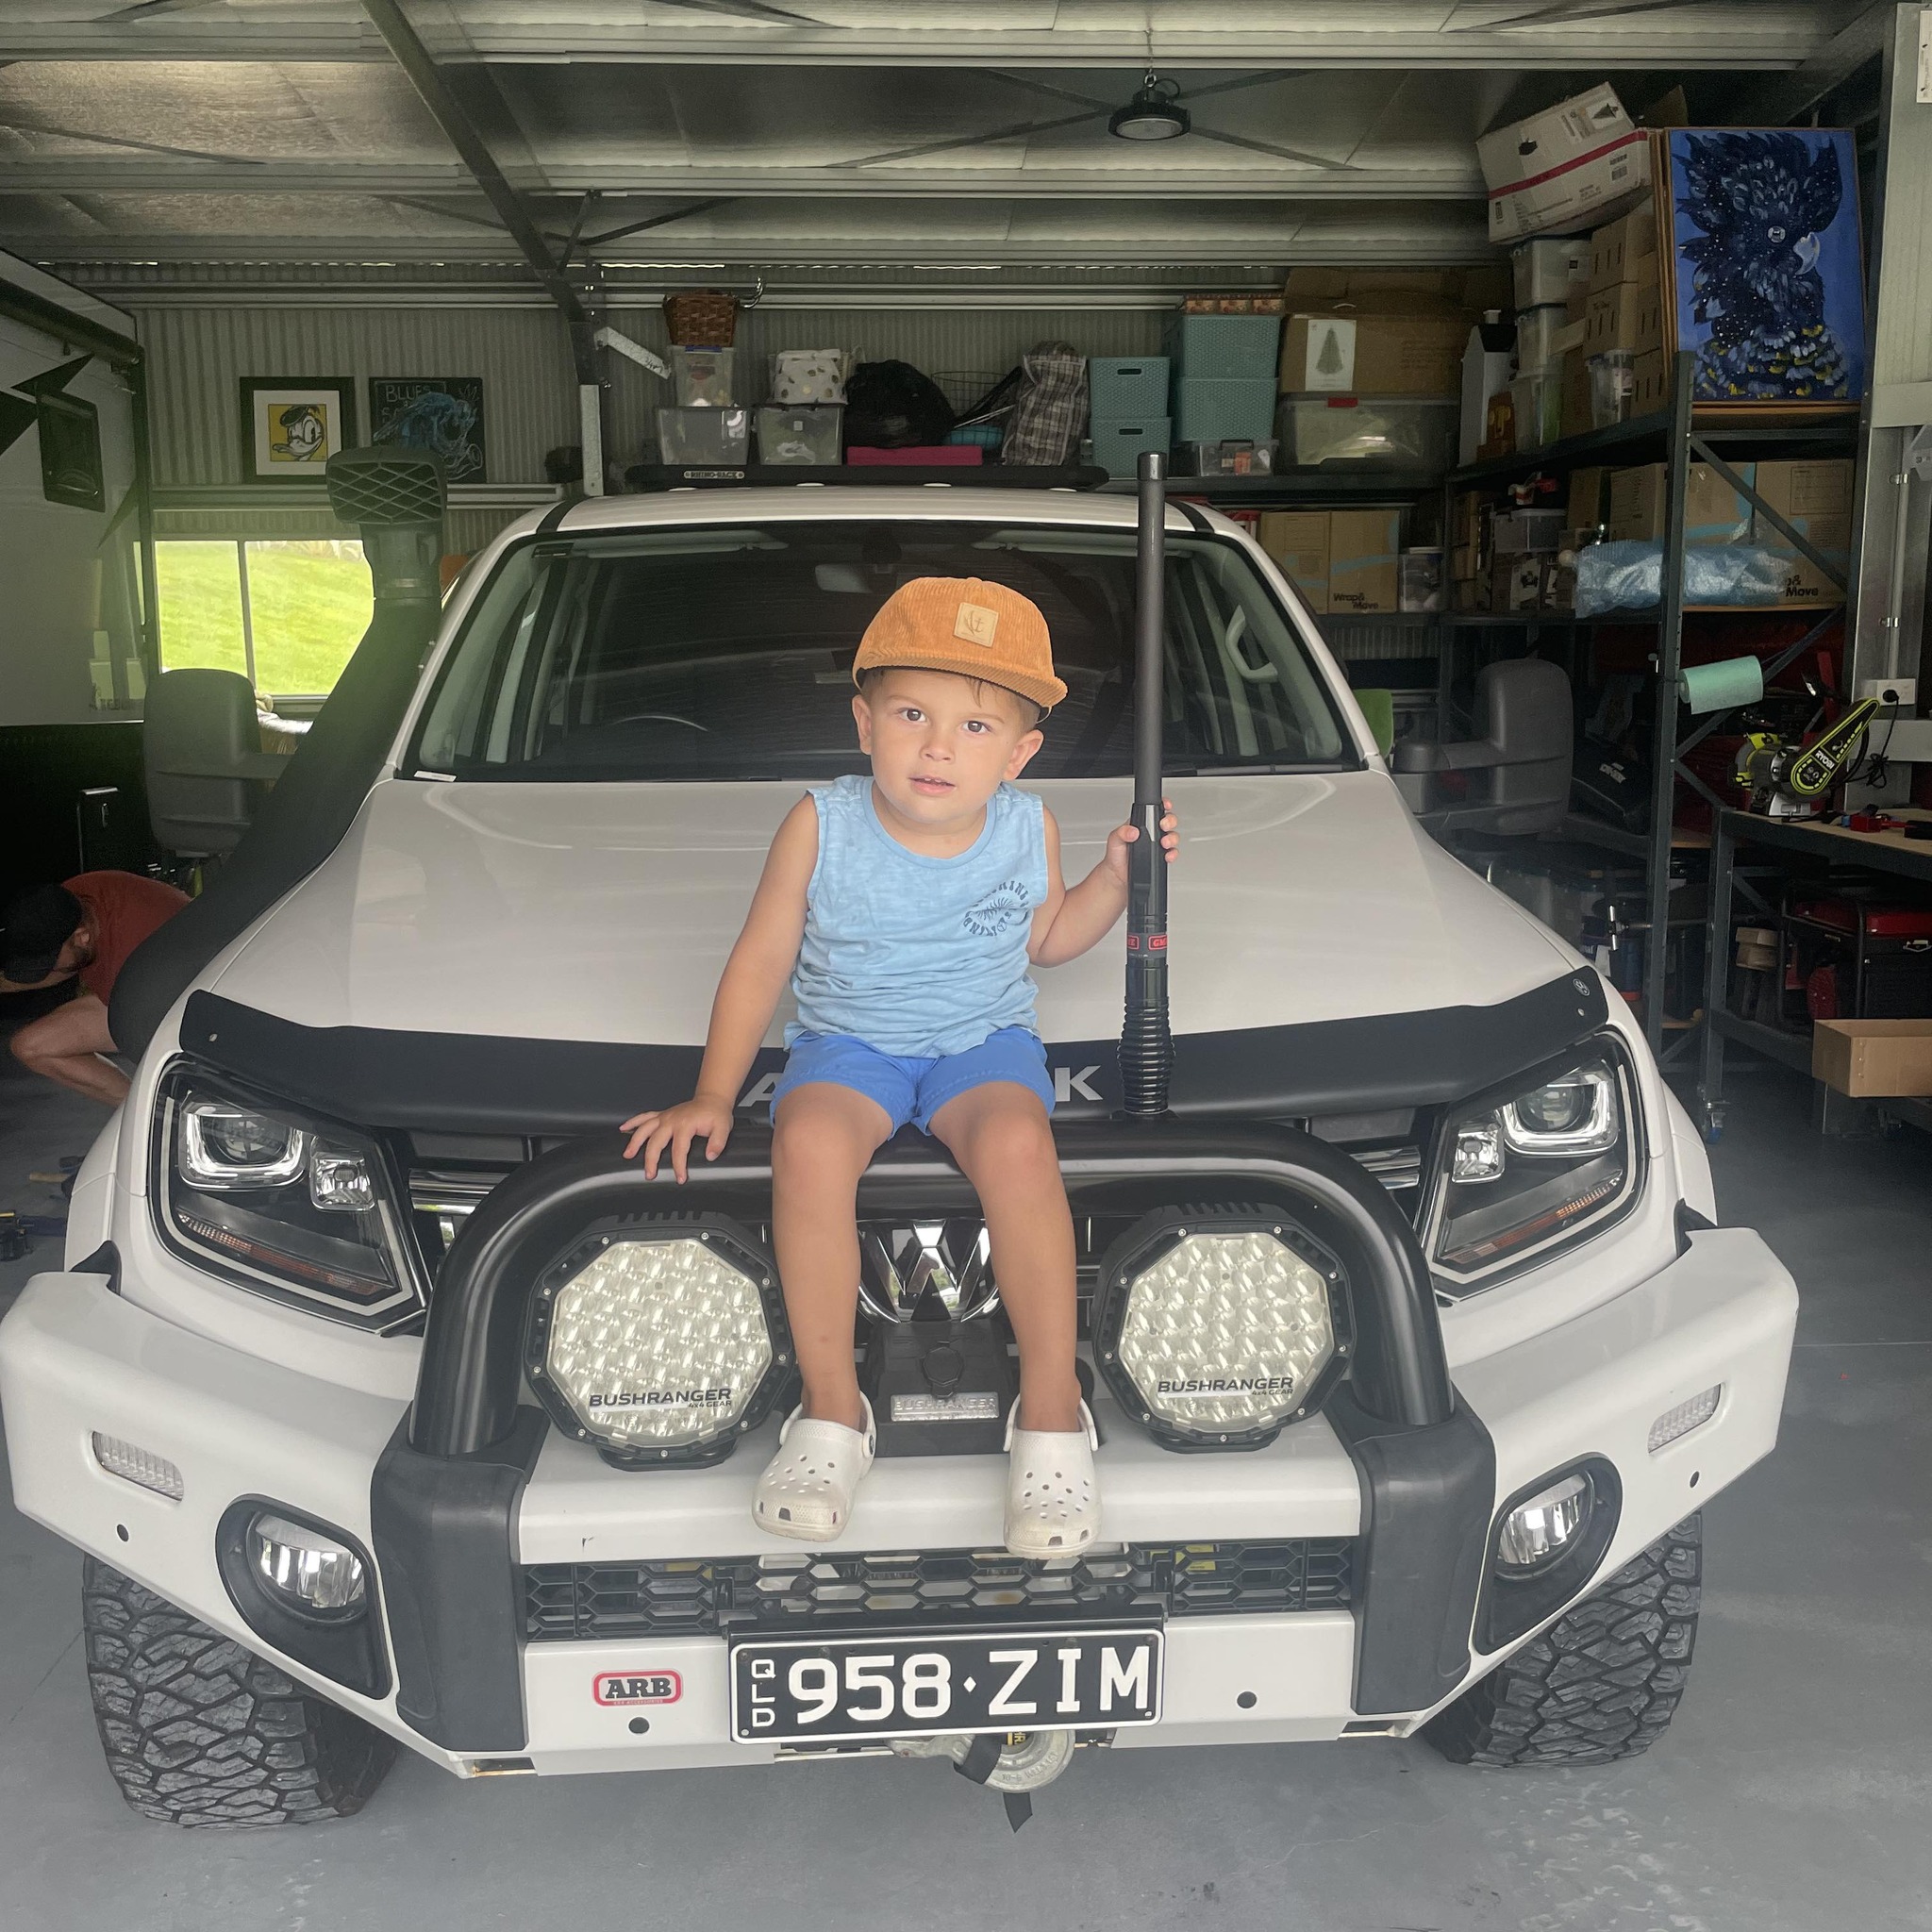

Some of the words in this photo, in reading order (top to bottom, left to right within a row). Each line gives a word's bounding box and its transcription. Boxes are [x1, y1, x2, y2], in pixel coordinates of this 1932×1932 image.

[1786, 588, 1819, 597] Move
[1815, 750, 1835, 770] RYOBI
[1158, 1377, 1294, 1392] BUSHRANGER
[589, 1389, 732, 1407] BUSHRANGER
[605, 1677, 672, 1699] ARB
[751, 1658, 776, 1727] QLD
[788, 1654, 951, 1724] 958
[988, 1646, 1150, 1716] ZIM
